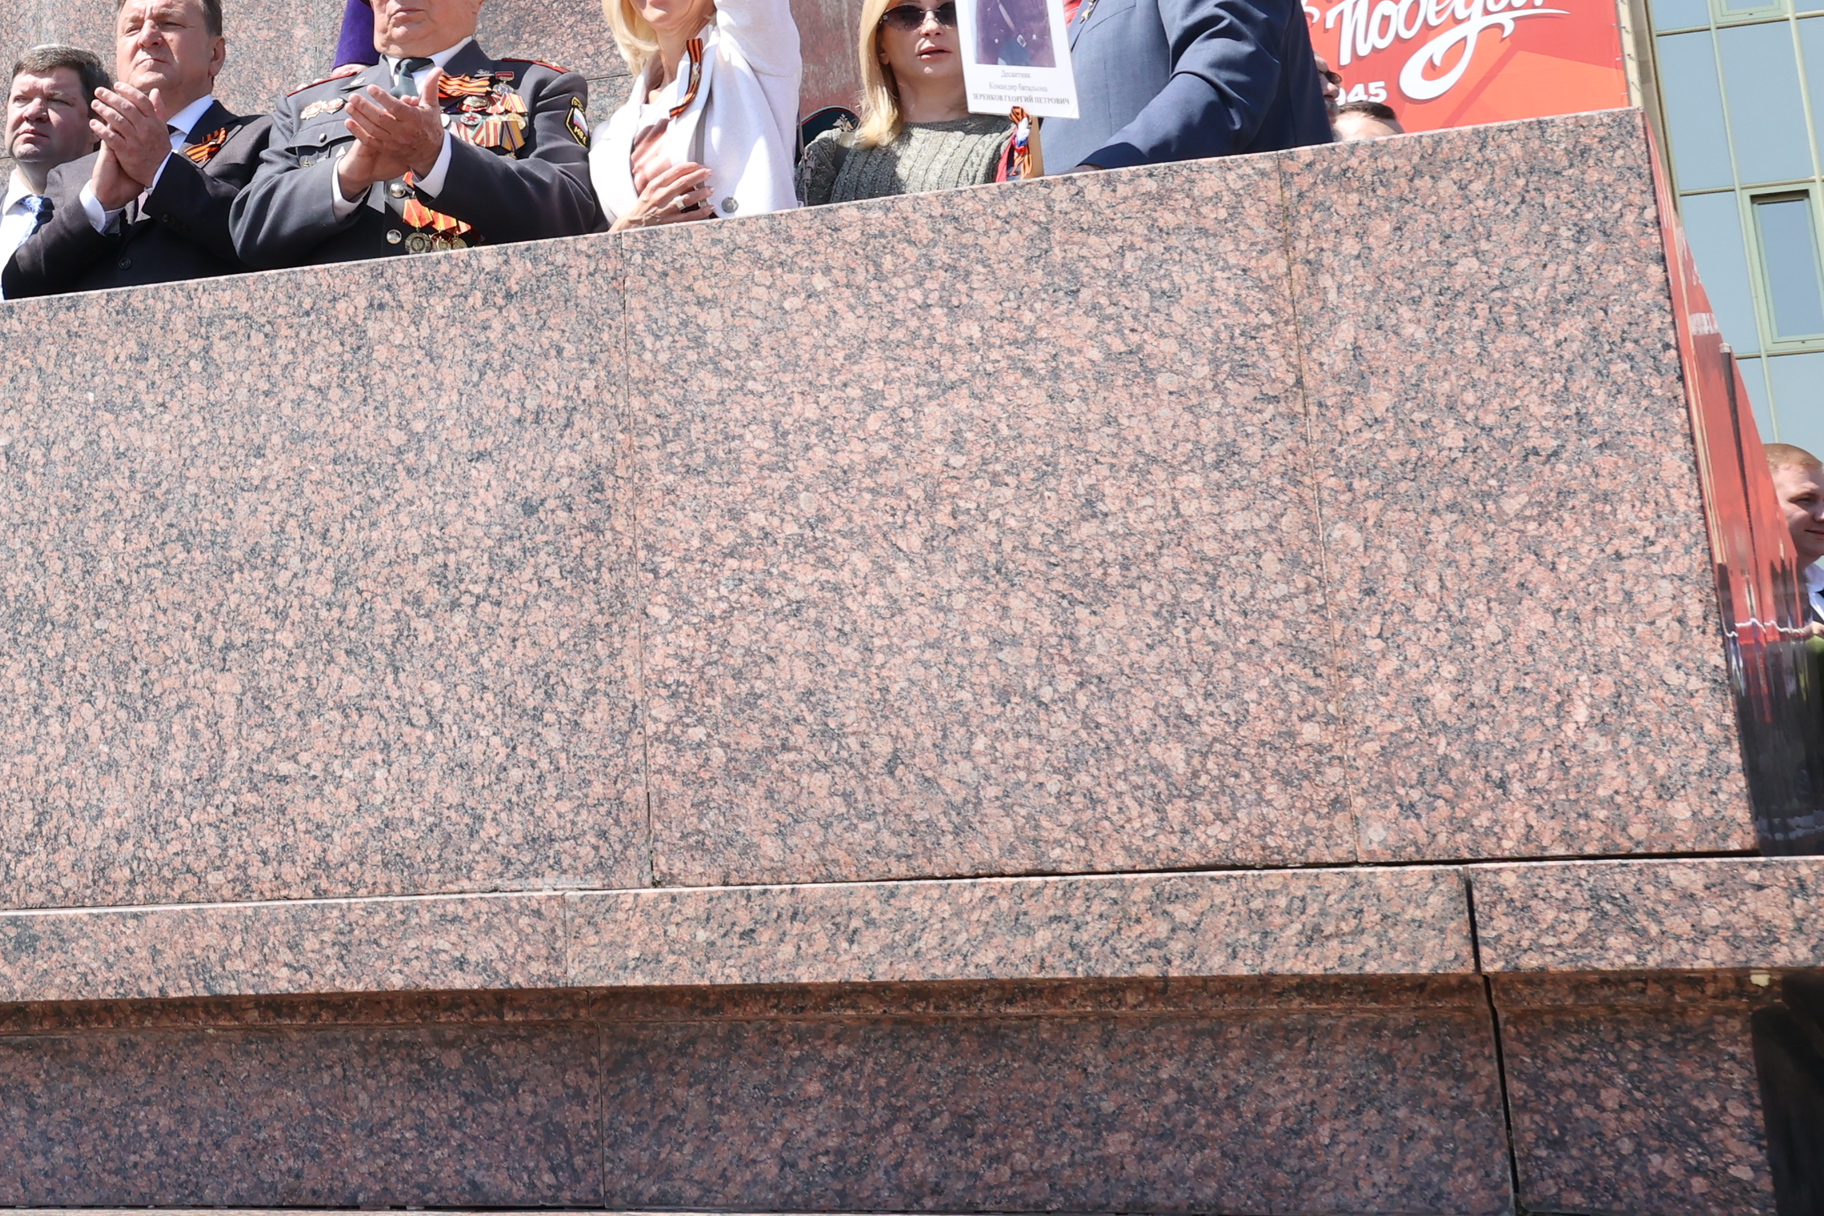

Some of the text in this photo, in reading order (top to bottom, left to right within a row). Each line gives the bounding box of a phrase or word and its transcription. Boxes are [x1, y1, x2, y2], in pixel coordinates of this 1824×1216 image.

[988, 82, 1048, 92] Командир батальона
[1004, 94, 1034, 103] ГЕОРГИЙ
[1034, 96, 1070, 105] ПЕТРОВИЧ
